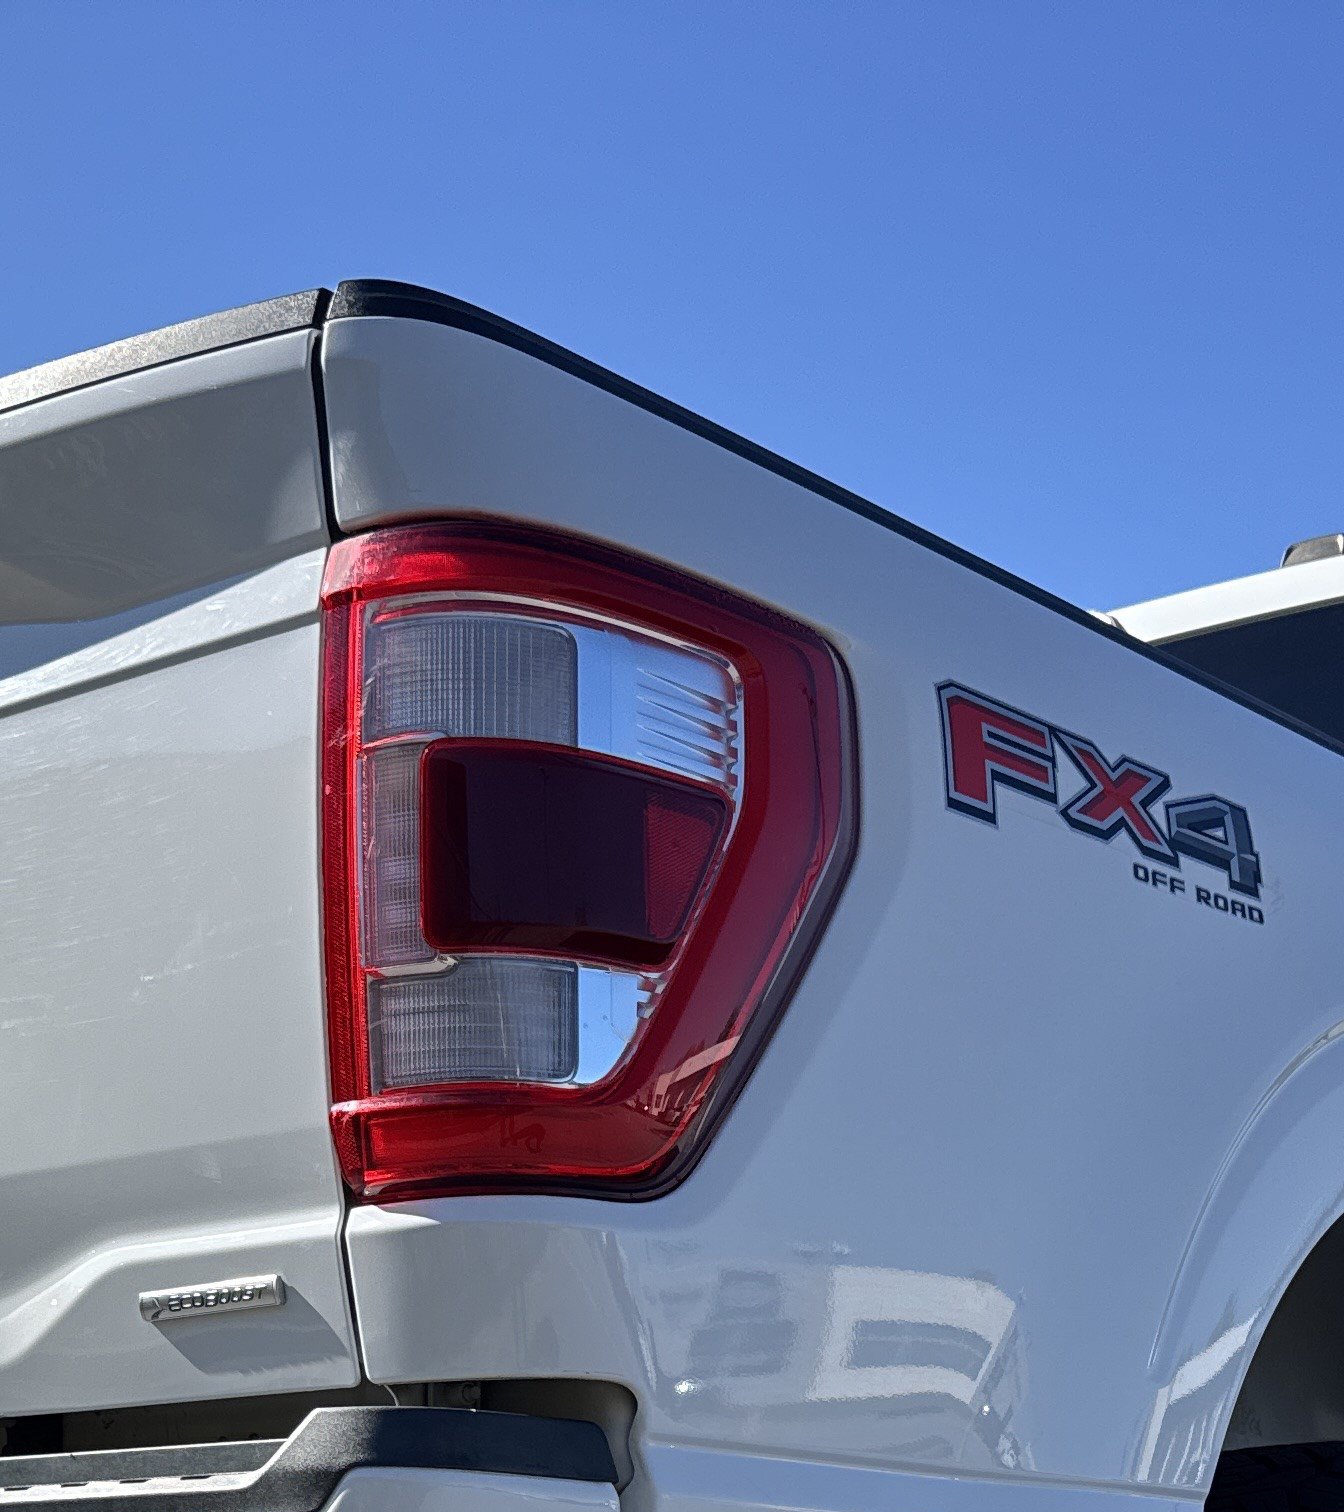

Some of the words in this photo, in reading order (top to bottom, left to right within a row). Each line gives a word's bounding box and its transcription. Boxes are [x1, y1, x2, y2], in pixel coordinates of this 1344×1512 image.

[934, 679, 1265, 900] FX4
[1132, 861, 1187, 896] OFF
[1195, 886, 1265, 926] ROAD
